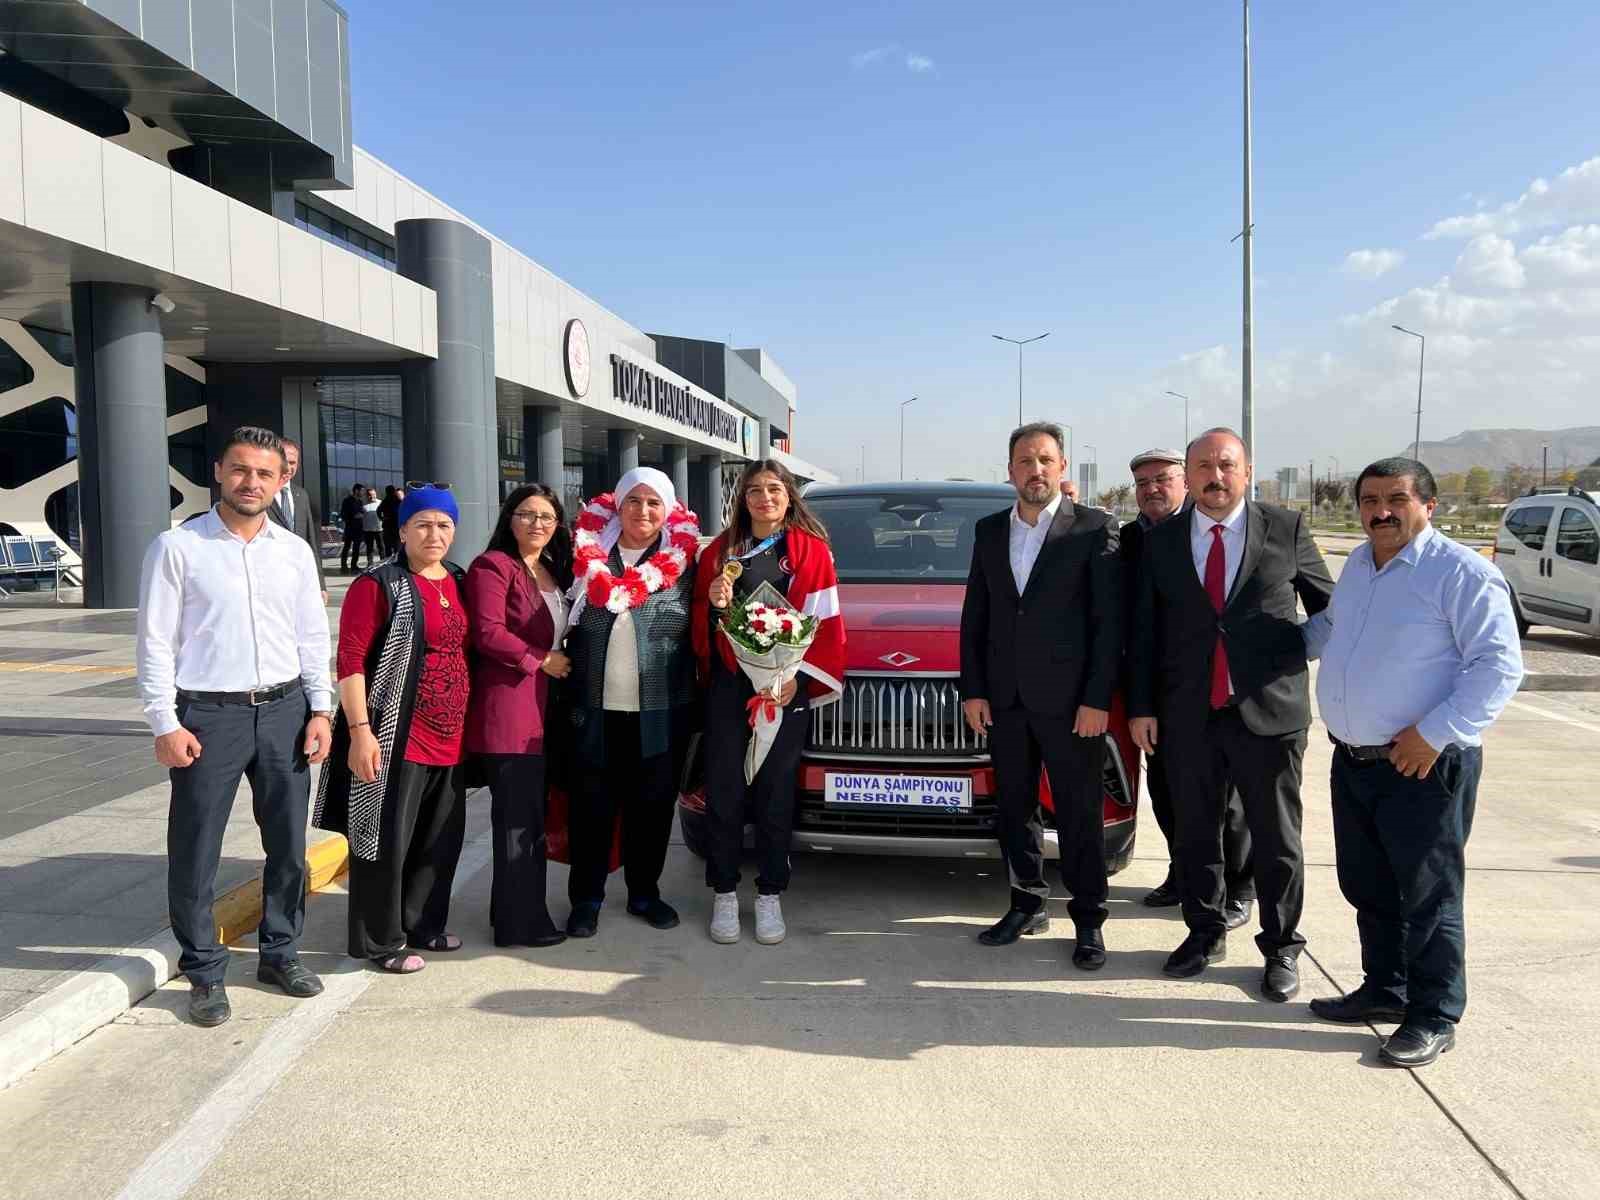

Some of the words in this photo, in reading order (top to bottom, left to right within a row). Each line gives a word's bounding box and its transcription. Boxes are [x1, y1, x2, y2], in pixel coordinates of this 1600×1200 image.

[609, 353, 655, 411] TOKAT
[834, 774, 880, 790] DÜNYA
[884, 777, 963, 793] ŞAMPİYONU
[836, 791, 909, 803] NESRİN
